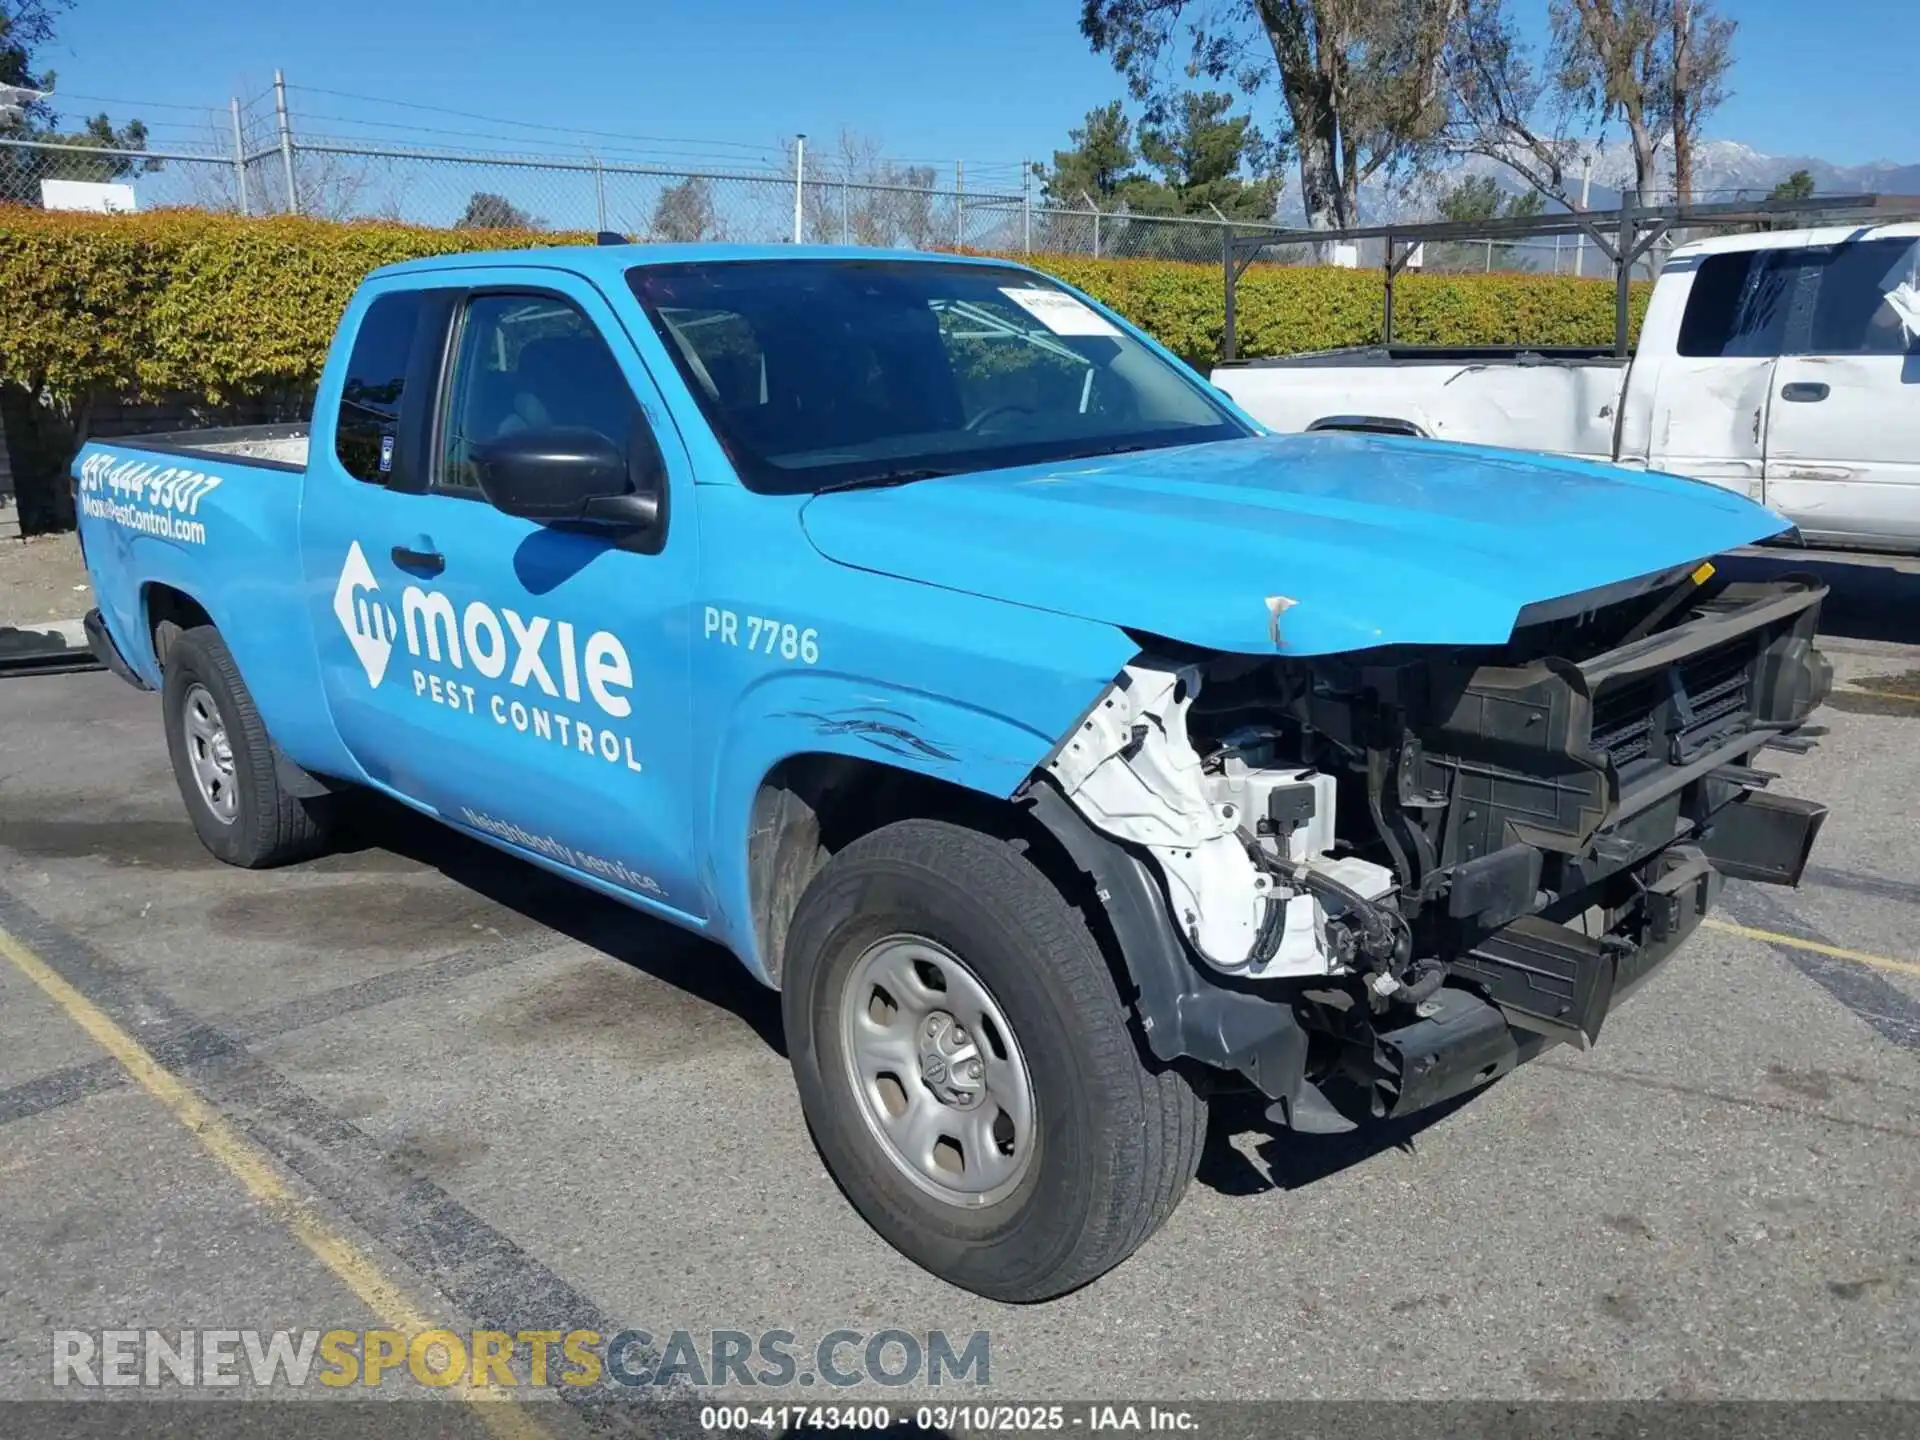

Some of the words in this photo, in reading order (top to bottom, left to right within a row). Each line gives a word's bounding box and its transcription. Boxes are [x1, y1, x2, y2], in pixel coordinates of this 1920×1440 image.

[81, 452, 224, 516] 951-444-9307
[704, 606, 738, 647] PR
[747, 615, 819, 665] 7786
[413, 669, 475, 715] PEST
[491, 695, 642, 773] CONTROL
